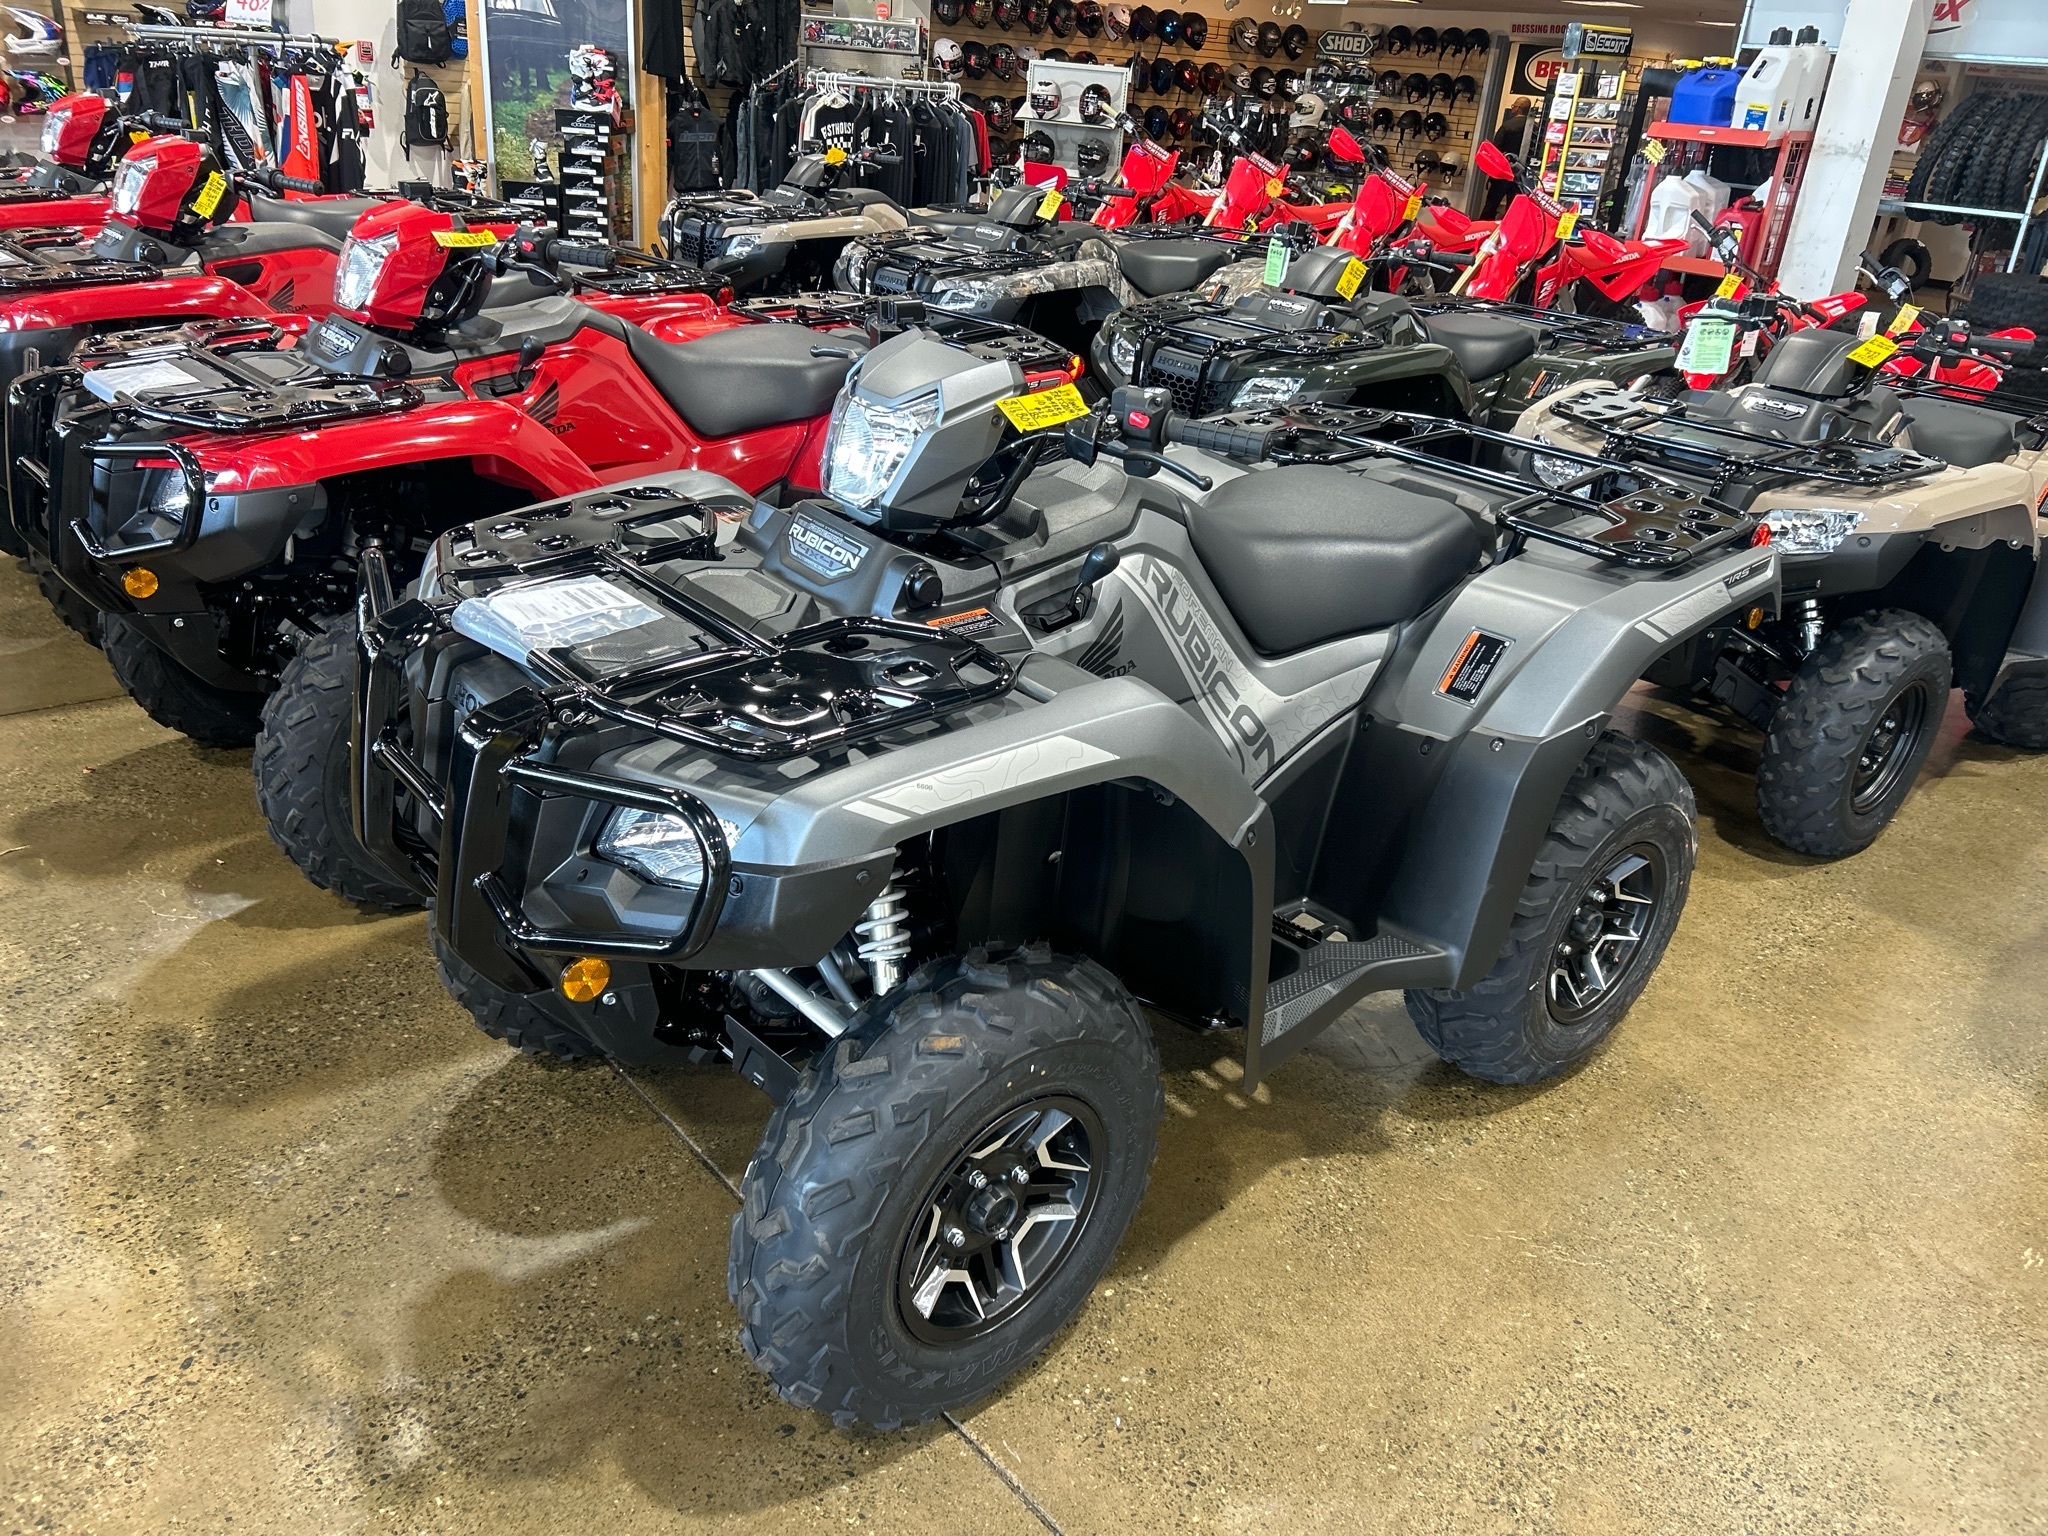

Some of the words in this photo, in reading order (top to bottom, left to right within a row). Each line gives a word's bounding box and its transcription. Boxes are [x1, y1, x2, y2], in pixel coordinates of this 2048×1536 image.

[1511, 24, 1548, 34] DRESSING
[1549, 25, 1567, 34] ROO
[1326, 35, 1366, 52] SHOEI
[1597, 35, 1629, 53] SCOTT
[1535, 60, 1569, 80] BE
[1464, 230, 1490, 241] HONDA
[1613, 252, 1640, 264] HONDA
[878, 274, 907, 287] HONDA
[319, 326, 355, 351] RUBICON
[1156, 355, 1199, 374] HONDA
[1741, 396, 1807, 415] RANCHER
[548, 422, 576, 436] NDA
[789, 522, 861, 570] RUBICON
[1728, 568, 1750, 585] IRS
[1171, 566, 1235, 673] FOREMAN
[1139, 554, 1275, 773] RUBICON
[1453, 644, 1471, 673] WARNING
[1104, 659, 1138, 679] NDA
[916, 782, 934, 792] 6600
[869, 1323, 1019, 1389] MAXXIS
